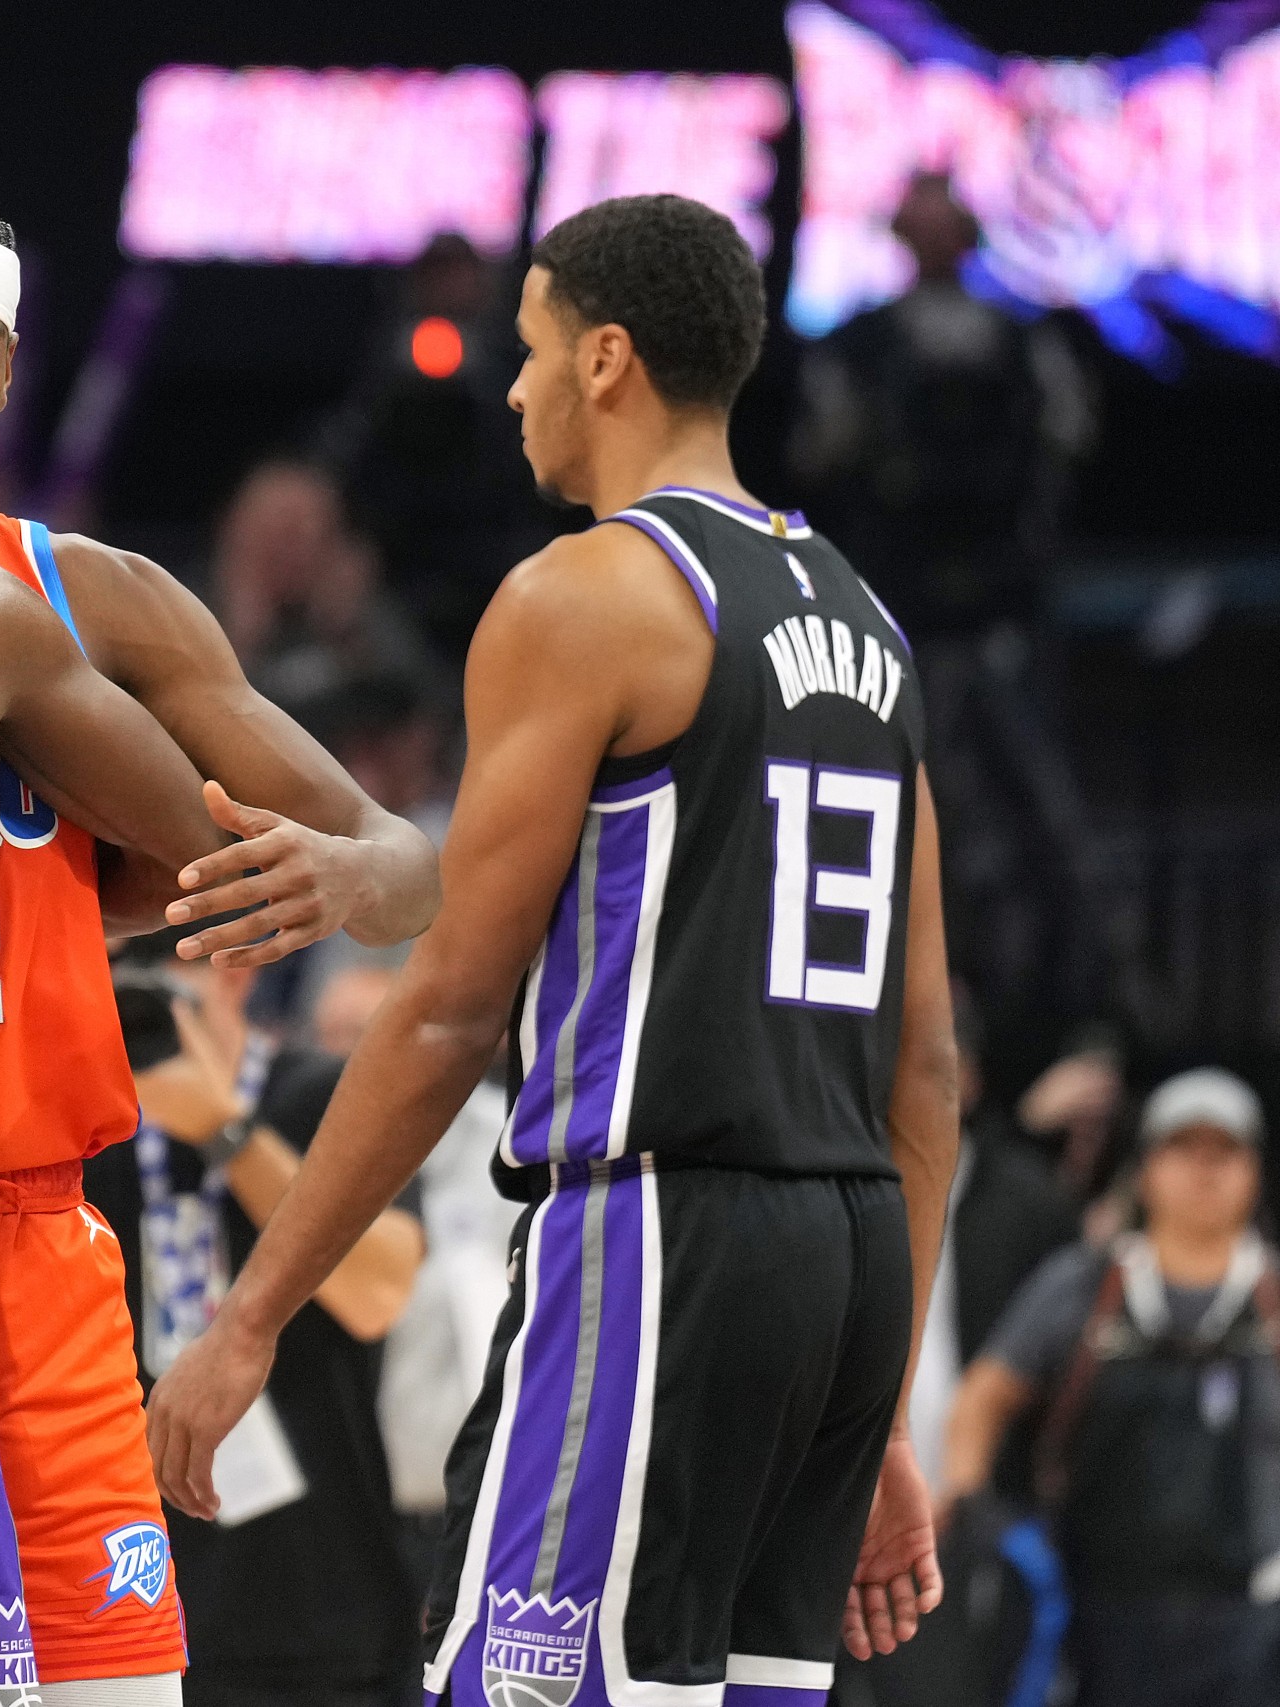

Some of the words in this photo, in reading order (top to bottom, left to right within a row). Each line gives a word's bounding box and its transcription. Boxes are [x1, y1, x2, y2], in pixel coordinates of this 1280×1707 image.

[762, 614, 904, 724] MURRAY
[763, 756, 903, 1016] 13
[109, 1537, 160, 1593] OKC
[484, 1641, 582, 1678] KINGS
[490, 1624, 584, 1648] SACRAMENTO
